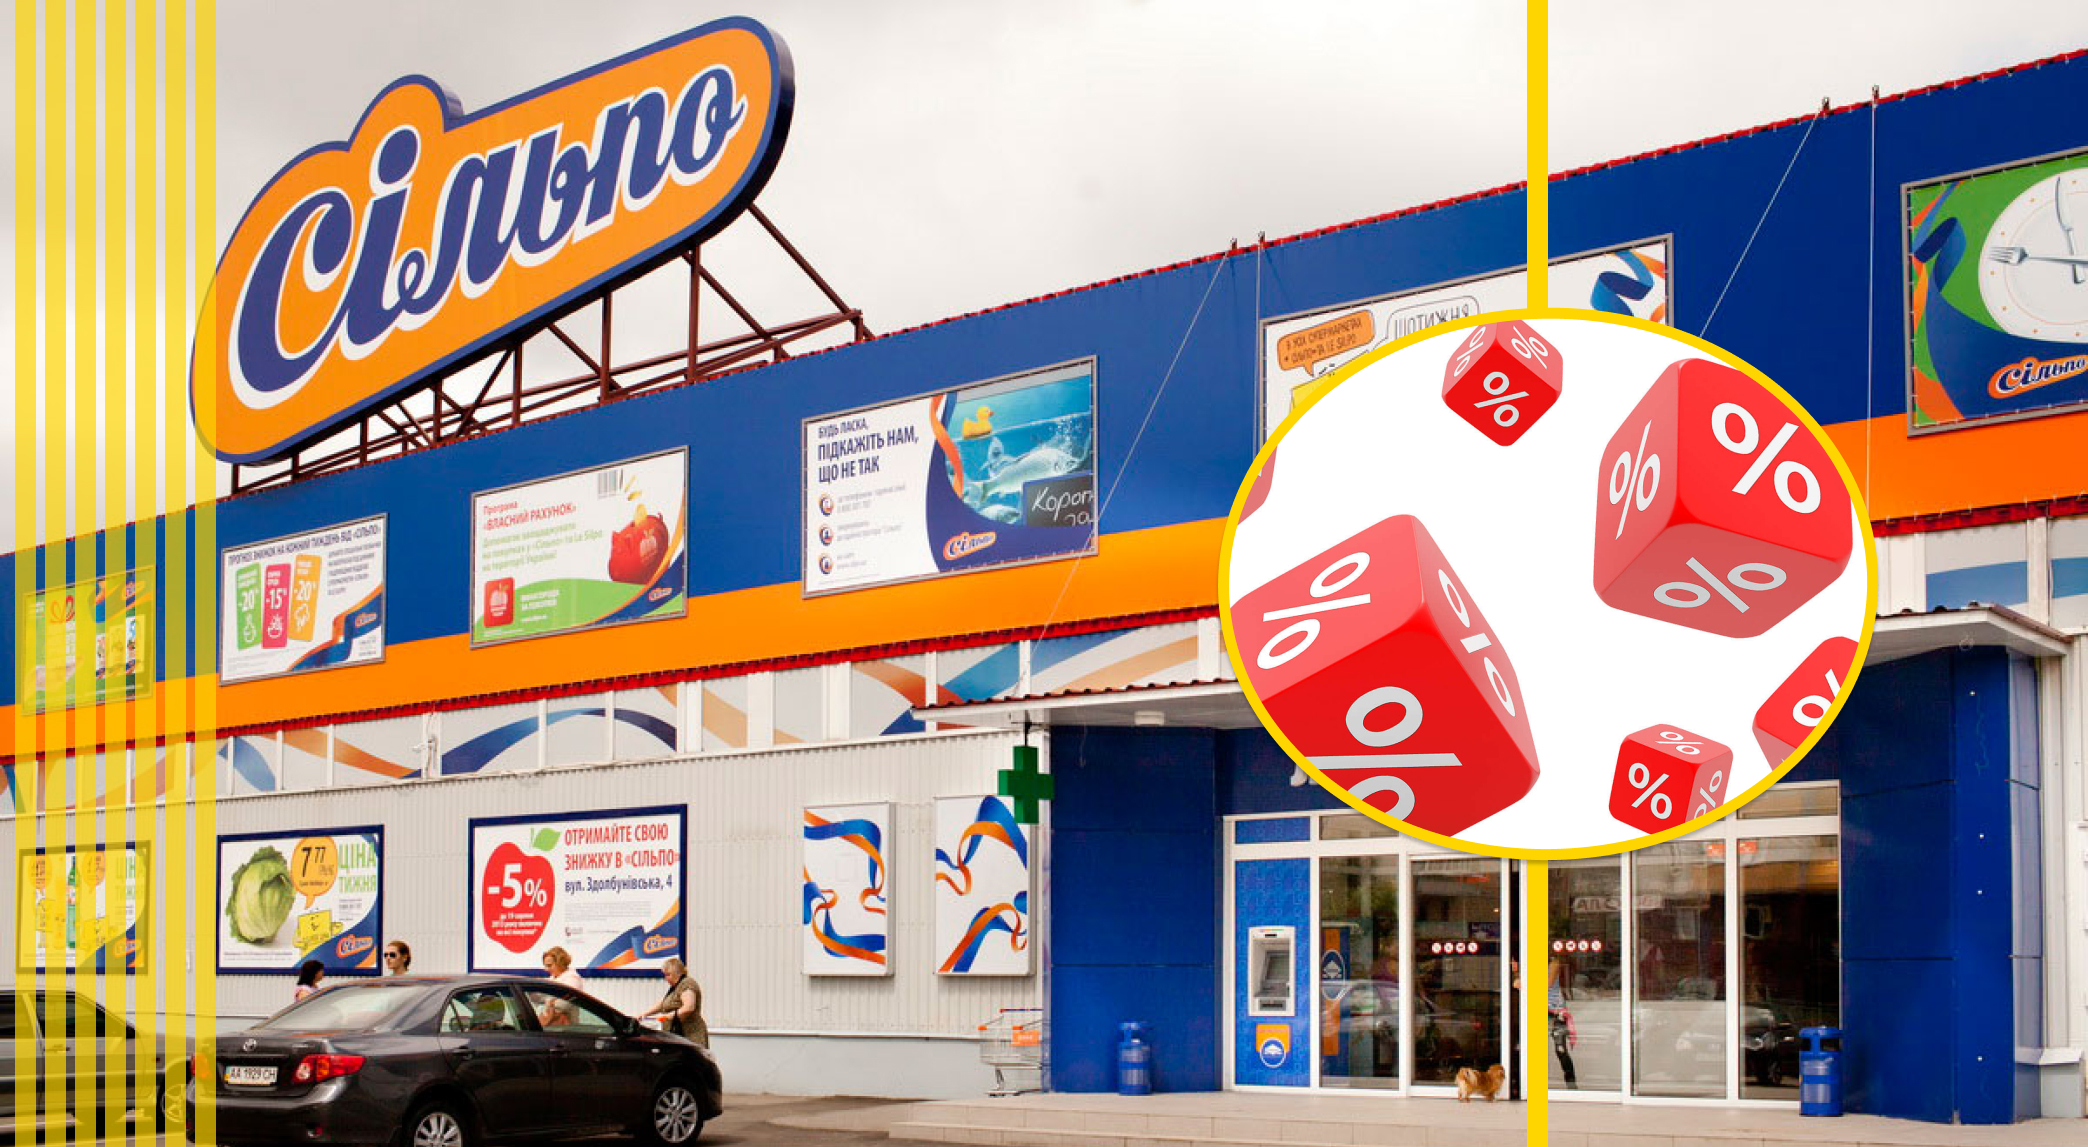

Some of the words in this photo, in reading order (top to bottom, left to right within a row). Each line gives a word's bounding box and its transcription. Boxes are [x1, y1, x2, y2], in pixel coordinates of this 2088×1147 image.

[230, 64, 748, 408] Сільпо
[1996, 357, 2086, 394] Сільпо
[818, 424, 839, 438] БУДЬ
[818, 432, 885, 461] ПІДКАЖІТЬ
[886, 424, 919, 447] НАМ,
[818, 463, 839, 485] ЩО
[841, 460, 856, 479] НЕ
[858, 455, 880, 475] ТАК
[565, 822, 632, 846] ОТРИМАЙТЕ
[634, 823, 668, 842] СВОЮ
[302, 846, 312, 877] 7
[339, 842, 376, 873] ЦІНА
[565, 851, 613, 871] ЗНИЖКУ
[615, 851, 622, 869] В
[487, 863, 547, 909] -5%
[565, 881, 585, 895] вул.
[587, 874, 664, 894] Здолбунівська,
[666, 873, 673, 888] 4
